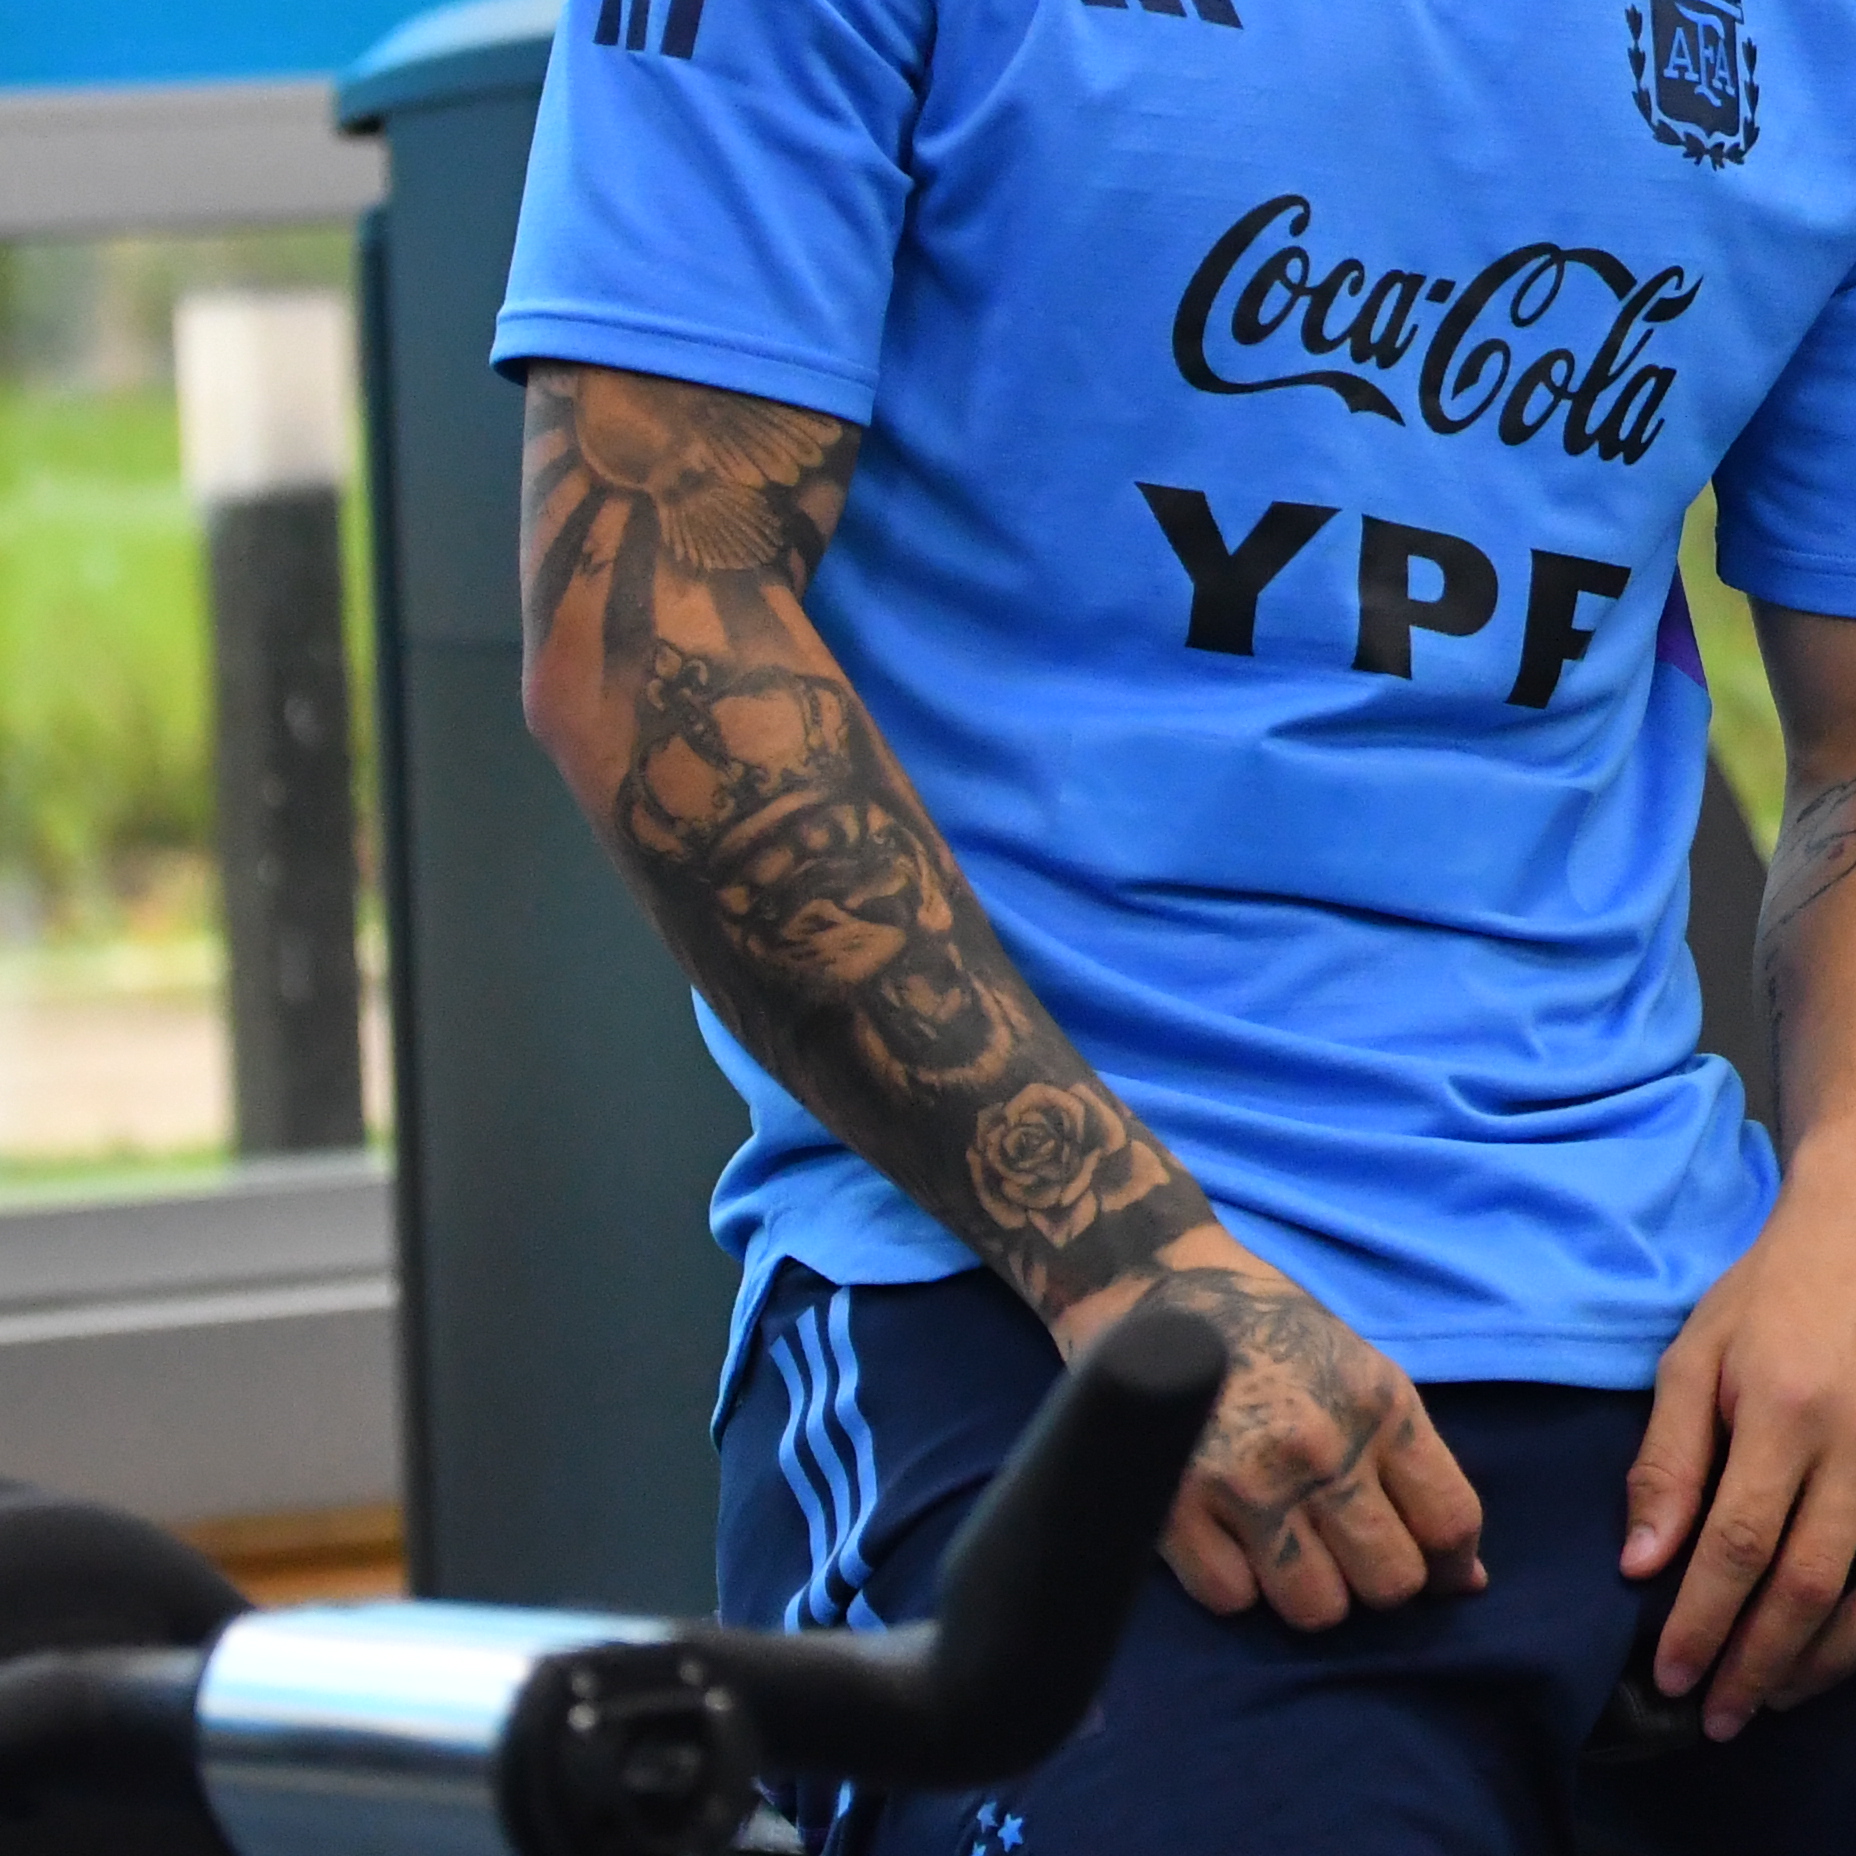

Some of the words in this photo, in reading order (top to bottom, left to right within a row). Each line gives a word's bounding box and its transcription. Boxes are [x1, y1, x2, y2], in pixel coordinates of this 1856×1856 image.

[1663, 1, 1736, 108] AFA
[1172, 193, 1704, 466] Coca-Cola
[1135, 480, 1632, 710] YPF
